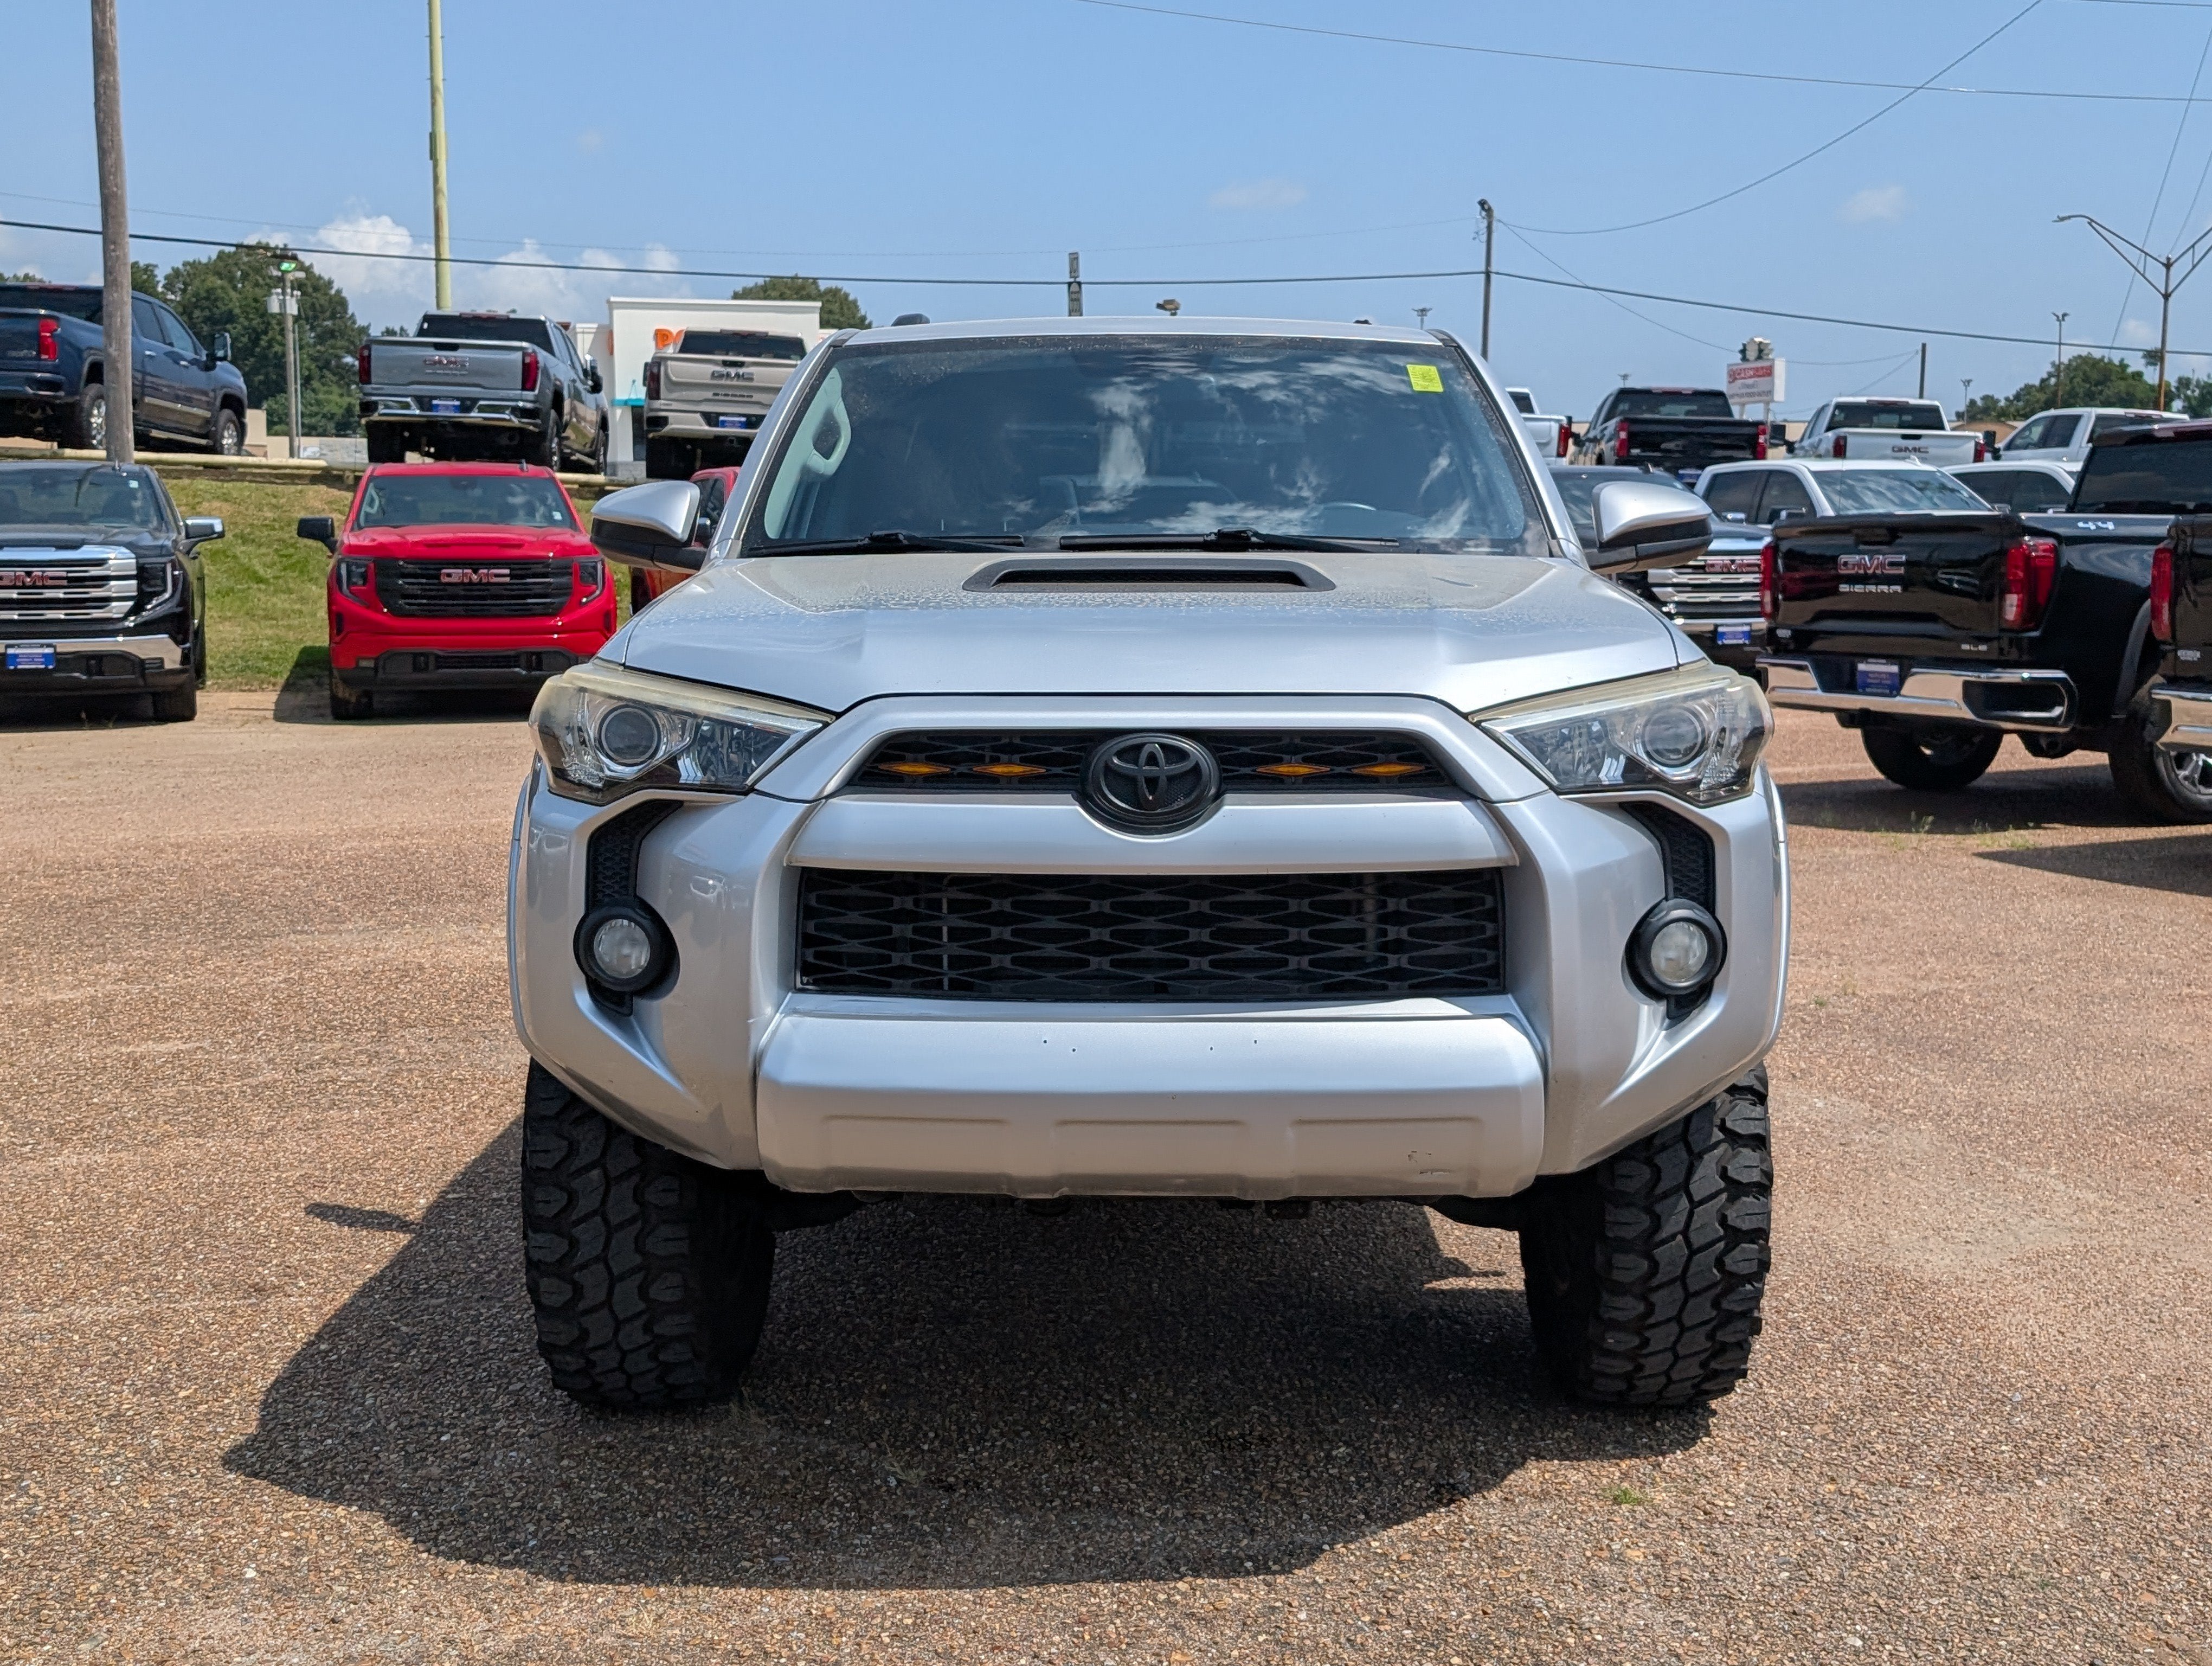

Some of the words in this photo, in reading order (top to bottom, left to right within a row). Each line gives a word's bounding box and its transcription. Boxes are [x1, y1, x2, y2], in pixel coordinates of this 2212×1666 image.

[711, 370, 755, 382] GMC
[1706, 560, 1761, 572] GMC
[1838, 555, 1906, 574] GMC
[441, 569, 510, 583] GMC
[1838, 584, 1902, 593] SIERRA
